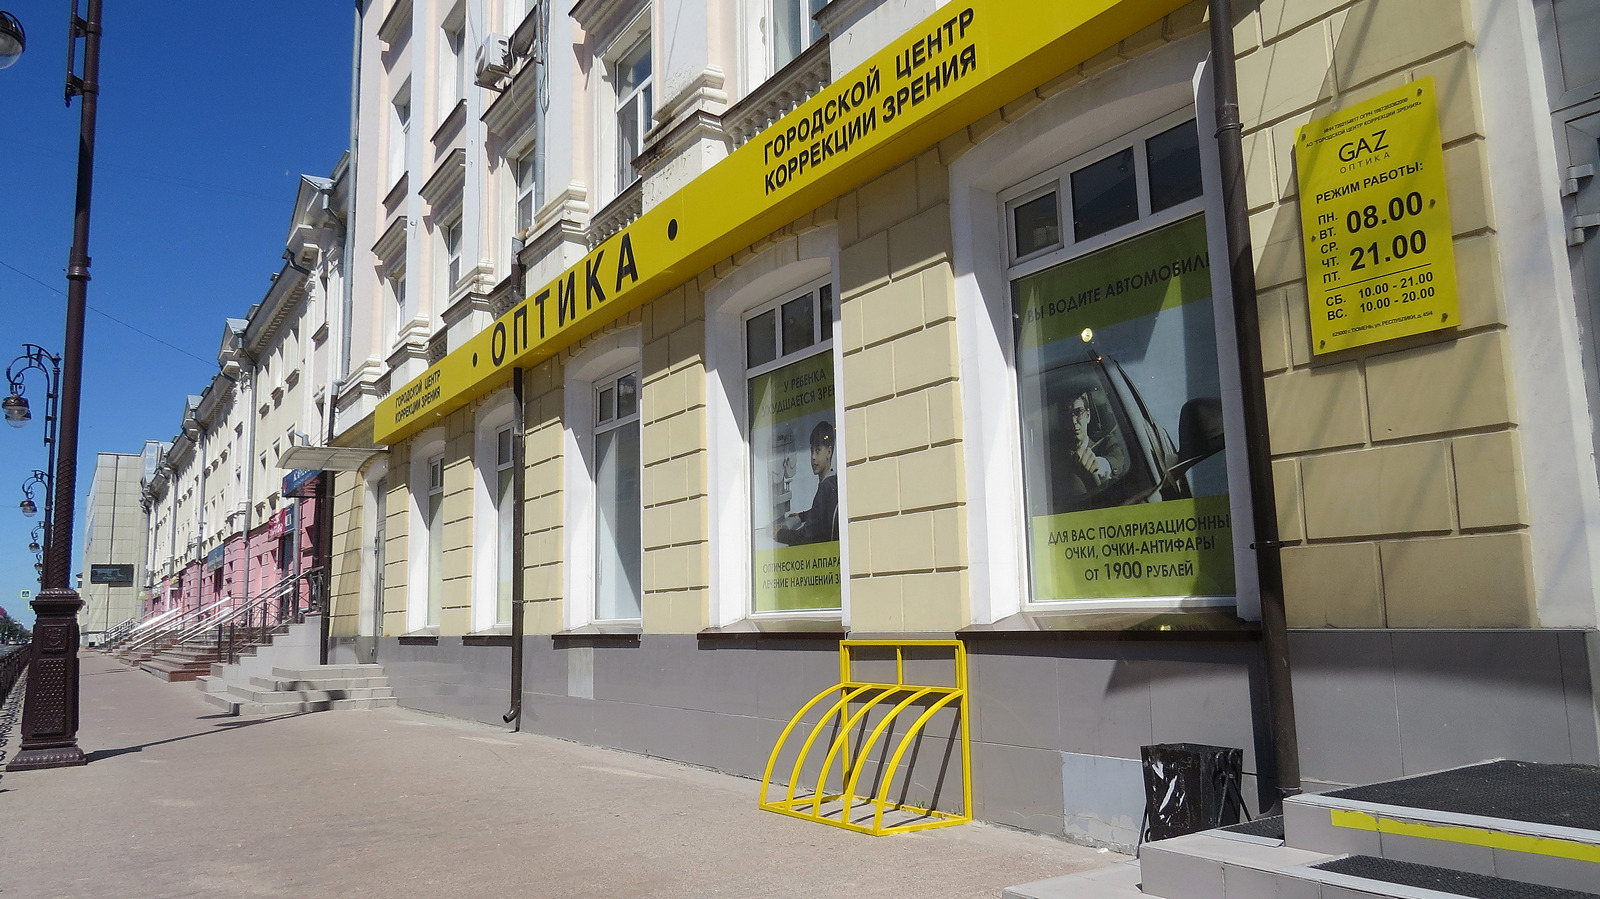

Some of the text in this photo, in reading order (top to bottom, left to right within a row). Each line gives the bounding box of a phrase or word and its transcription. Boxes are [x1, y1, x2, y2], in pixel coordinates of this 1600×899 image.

[764, 7, 974, 165] ГОРОДСКОЙ ЦЕНТР
[765, 43, 976, 196] КОРРЕКЦИИ ЗРЕНИЯ
[1346, 122, 1363, 133] ЦЕНТР
[1364, 110, 1395, 125] КОРРЕКЦИИ
[1338, 129, 1389, 162] GAZ
[1340, 152, 1390, 174] ОПТИКА
[1316, 161, 1423, 204] РЕЖИМ РАБОТЫ:
[1318, 212, 1338, 225] ПН.
[1346, 191, 1423, 234] 08.00
[1319, 226, 1336, 240] ВТ.
[1320, 242, 1338, 254] СР.
[1349, 229, 1427, 272] 21.00
[1321, 256, 1339, 268] ЧТ.
[1323, 271, 1340, 284] ПТ.
[1326, 294, 1346, 307] СБ.
[1358, 283, 1389, 298] 10.00
[1400, 271, 1433, 288] 21.00
[492, 232, 638, 367] ОПТИКА
[1027, 308, 1044, 323] ВЫ
[1049, 287, 1101, 317] ВОДИТЕ
[1327, 308, 1348, 321] ВС.
[1360, 297, 1390, 313] 10.00
[1402, 286, 1435, 304] 20.00
[395, 369, 441, 409] ГОРОДСКОЙ ЦЕНТР
[783, 368, 826, 392] У РЕБЕНКА
[395, 386, 440, 424] КОРРЕКЦИИ ЗРЕНИЯ
[1048, 530, 1068, 546] ДЛЯ
[1071, 528, 1096, 542] ВАС
[1065, 536, 1215, 560] ОЧКИ, ОЧКИ-АНТИФАРЫ
[763, 559, 806, 573] ОПТИЧЕСКОЕ
[806, 560, 811, 569] И
[1104, 561, 1142, 581] 1900
[1146, 560, 1194, 578] РУБЛЕЙ
[791, 571, 833, 588] НАРУШЕНИЙ
